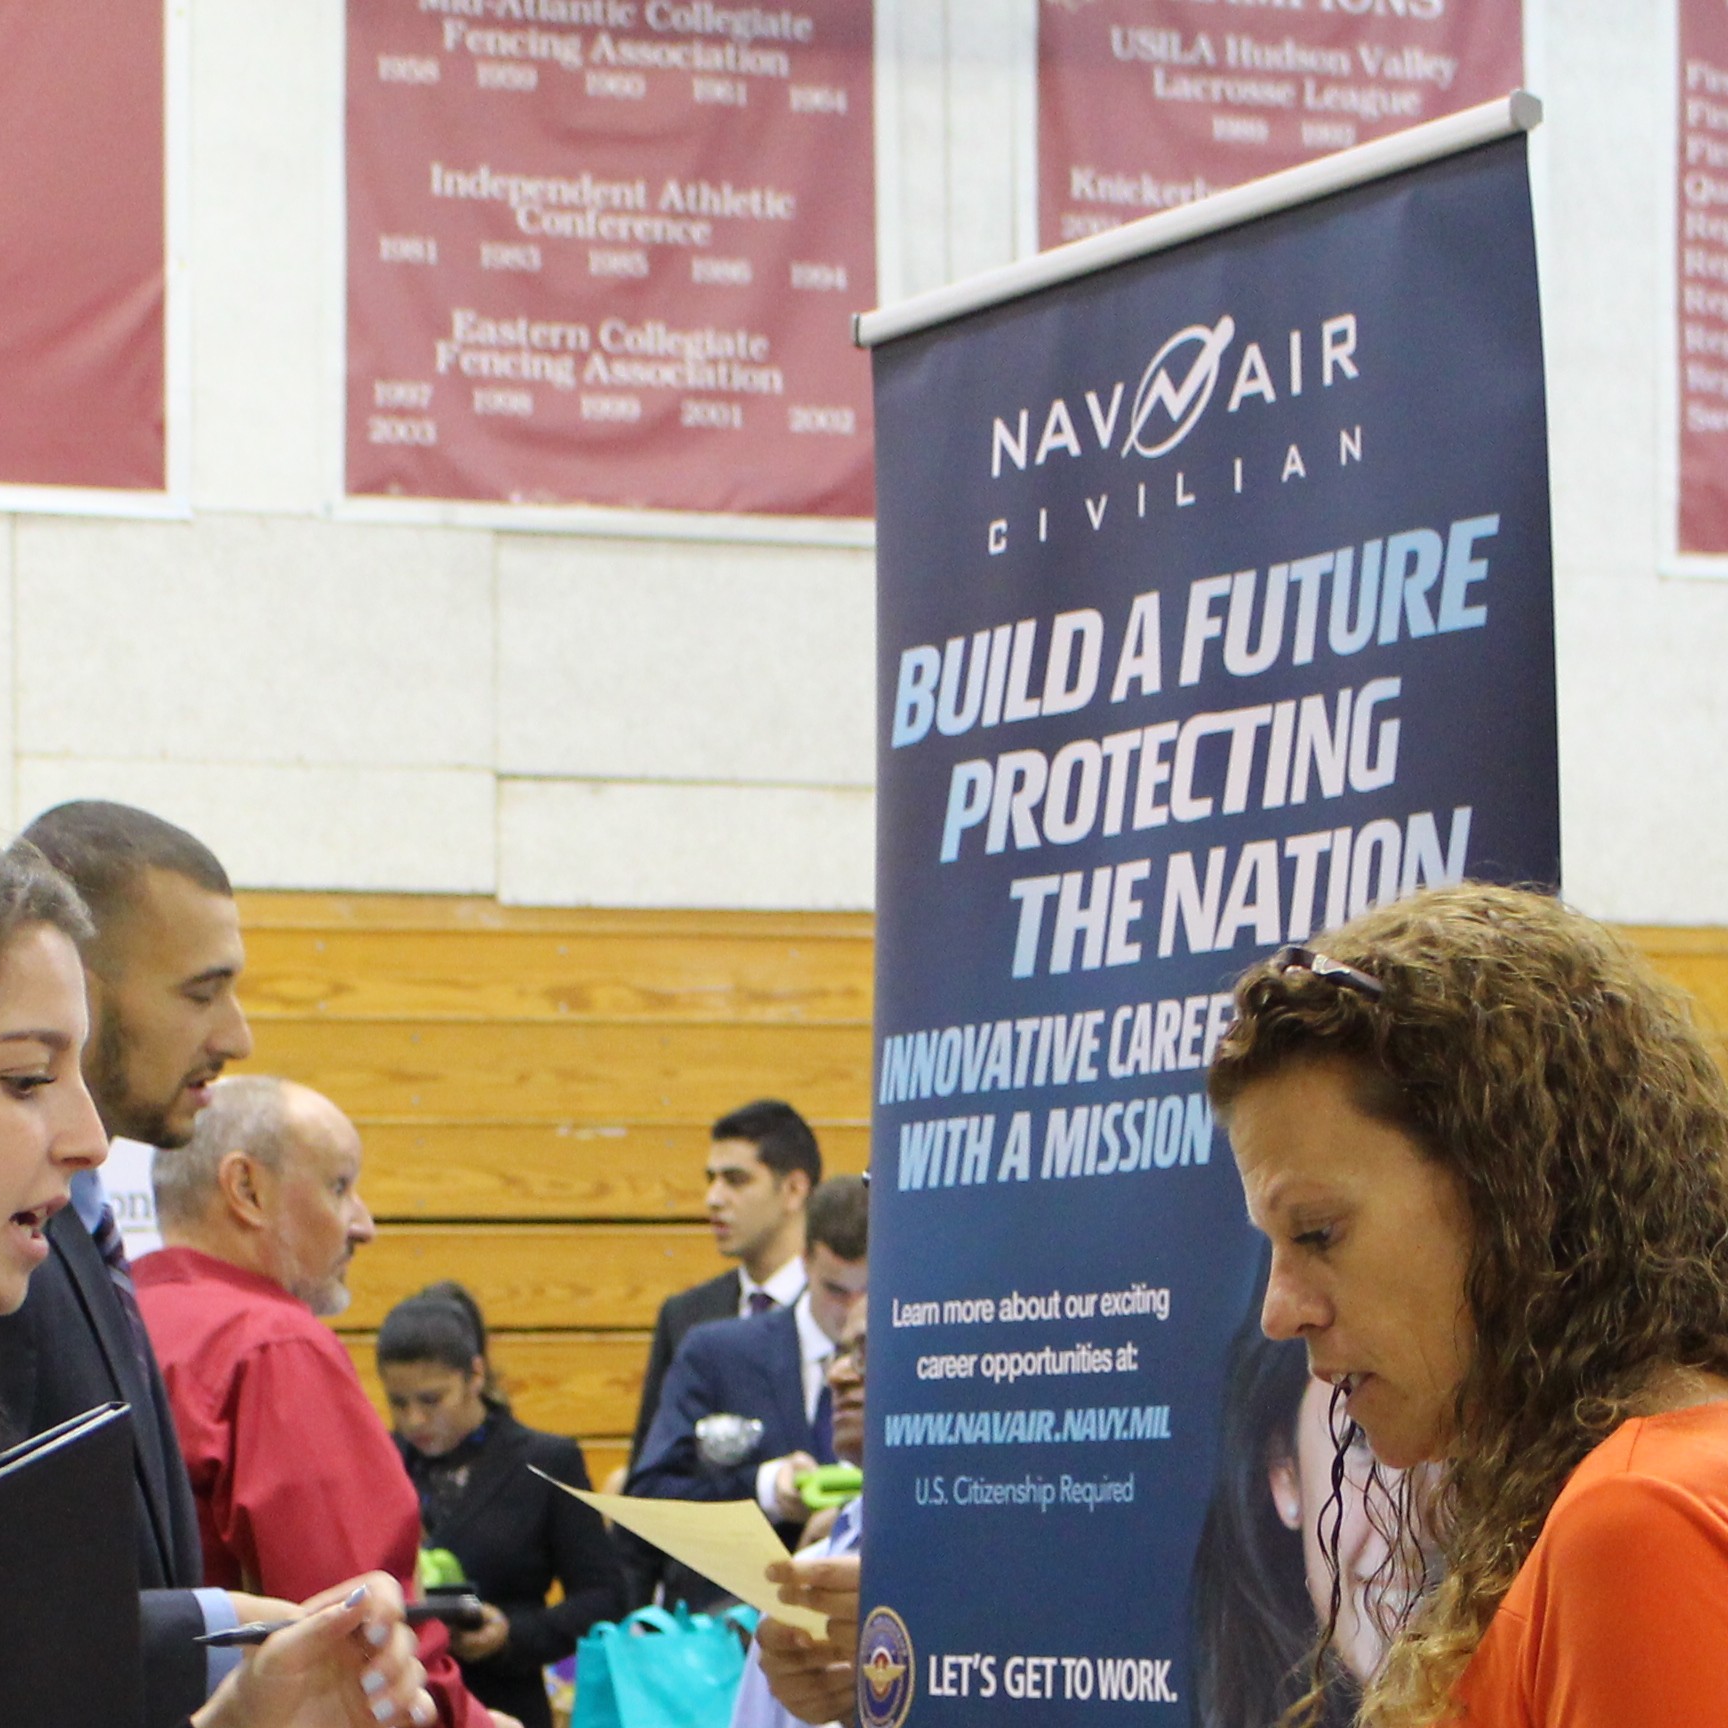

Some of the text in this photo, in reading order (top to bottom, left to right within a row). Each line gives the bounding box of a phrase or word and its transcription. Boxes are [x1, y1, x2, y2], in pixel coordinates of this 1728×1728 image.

[443, 17, 790, 77] Fencing Association
[1111, 25, 1460, 91] USILA Hudson Valley
[1153, 67, 1423, 122] Lacrosse League
[430, 161, 797, 221] Independent Athletic
[516, 205, 713, 247] Conference
[452, 308, 770, 363] Eastern Collegiate
[435, 338, 783, 396] Fencing Association
[987, 425, 1364, 557] CIVILIAN
[891, 513, 1501, 748] BUILD A FUTURE
[939, 676, 1402, 863] PROTECTING
[1010, 806, 1473, 979] THE NATION
[879, 992, 1235, 1104] INNOVATIVE CAREE
[897, 1092, 1213, 1192] WITH A MISSION
[892, 1282, 1171, 1328] Learn more about our exciting
[916, 1340, 1139, 1384] career opportunities at:
[884, 1405, 1172, 1447] WWW.NAVAIR.NAVY.MIL
[915, 1472, 1136, 1513] U.S. Citizenship Required
[928, 1651, 1178, 1703] LET'S GET TO WORK.
